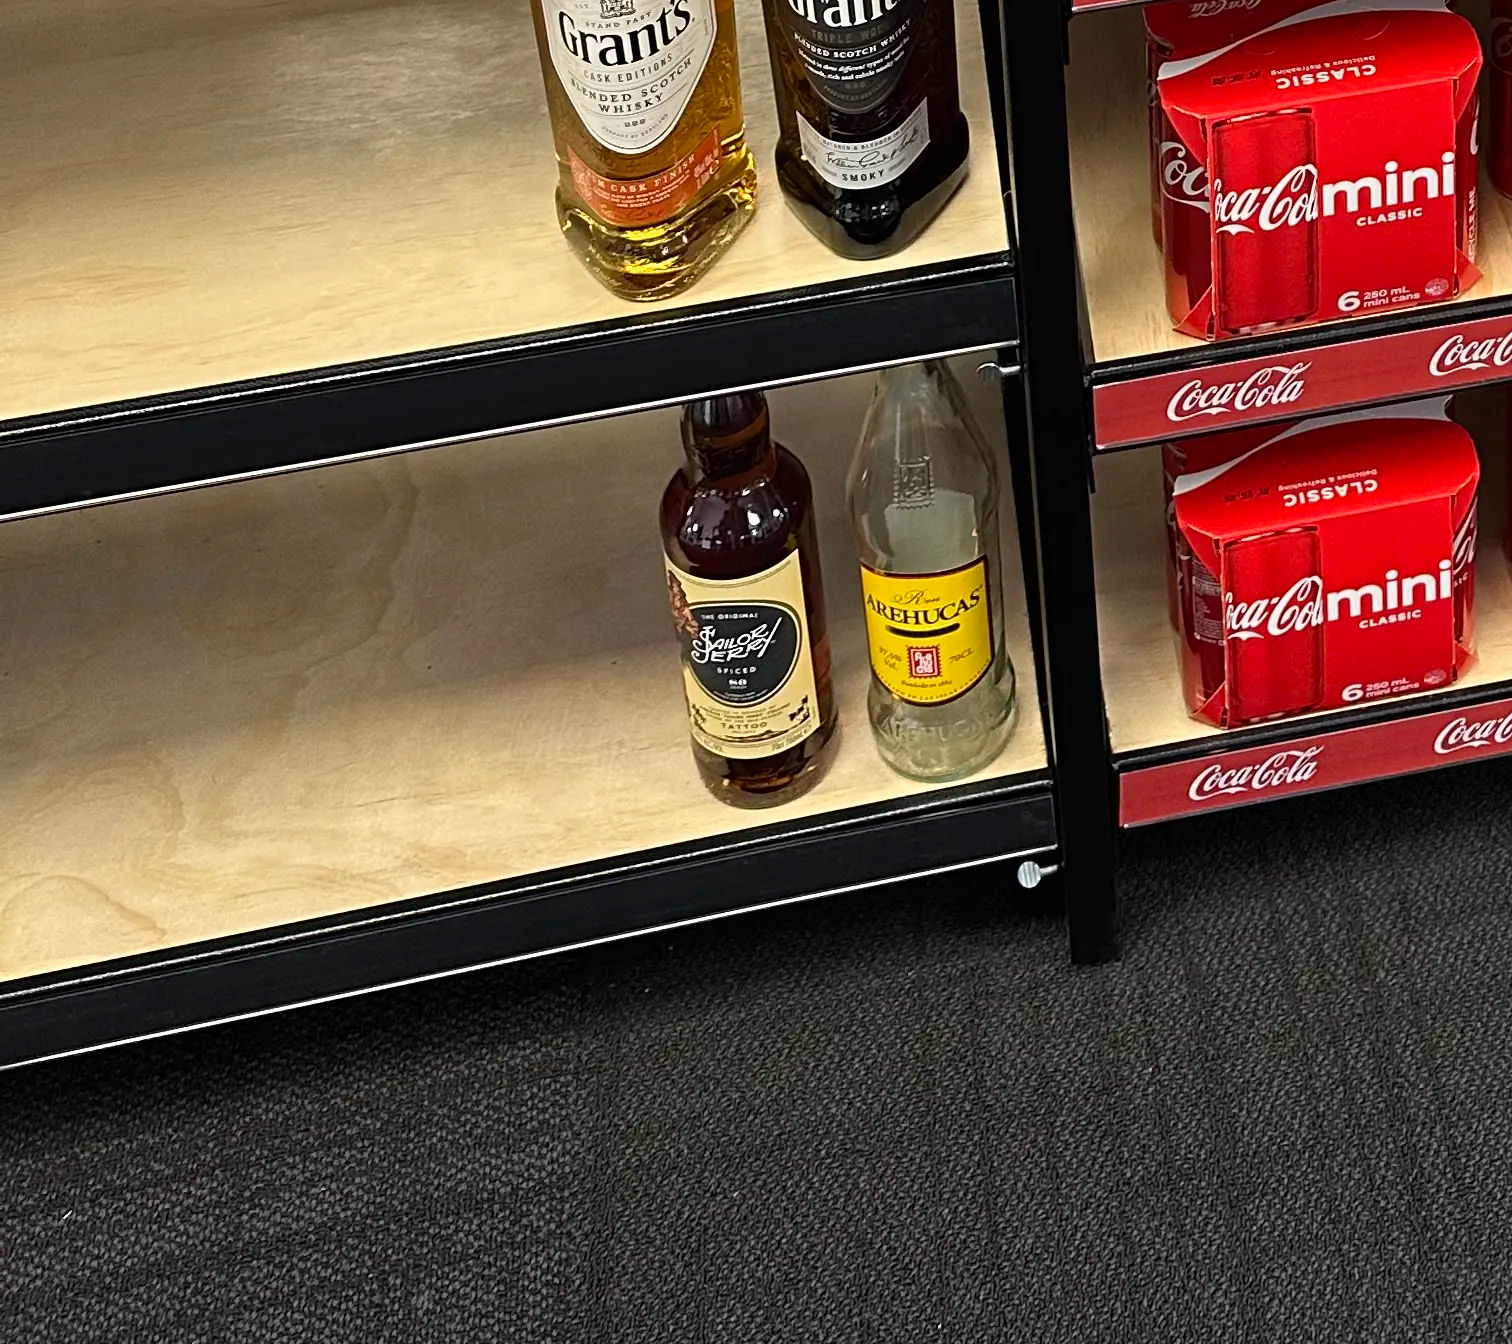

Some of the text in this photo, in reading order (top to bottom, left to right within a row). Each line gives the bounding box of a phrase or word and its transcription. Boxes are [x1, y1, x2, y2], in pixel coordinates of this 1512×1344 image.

[583, 53, 673, 83] CASK EDITIONS
[833, 46, 877, 58] SCOTCH
[641, 58, 692, 98] SCOTCH
[599, 93, 664, 113] WHISKY
[842, 170, 885, 181] SMOKY
[1323, 151, 1455, 216] mini
[1356, 207, 1423, 226] CLASSIC
[1167, 363, 1311, 421] Coca-Cola
[866, 586, 980, 625] AREHUCAS
[1323, 559, 1452, 621] mini
[1359, 609, 1422, 629] CLASSIC
[1189, 739, 1323, 800] Coca-Cola
